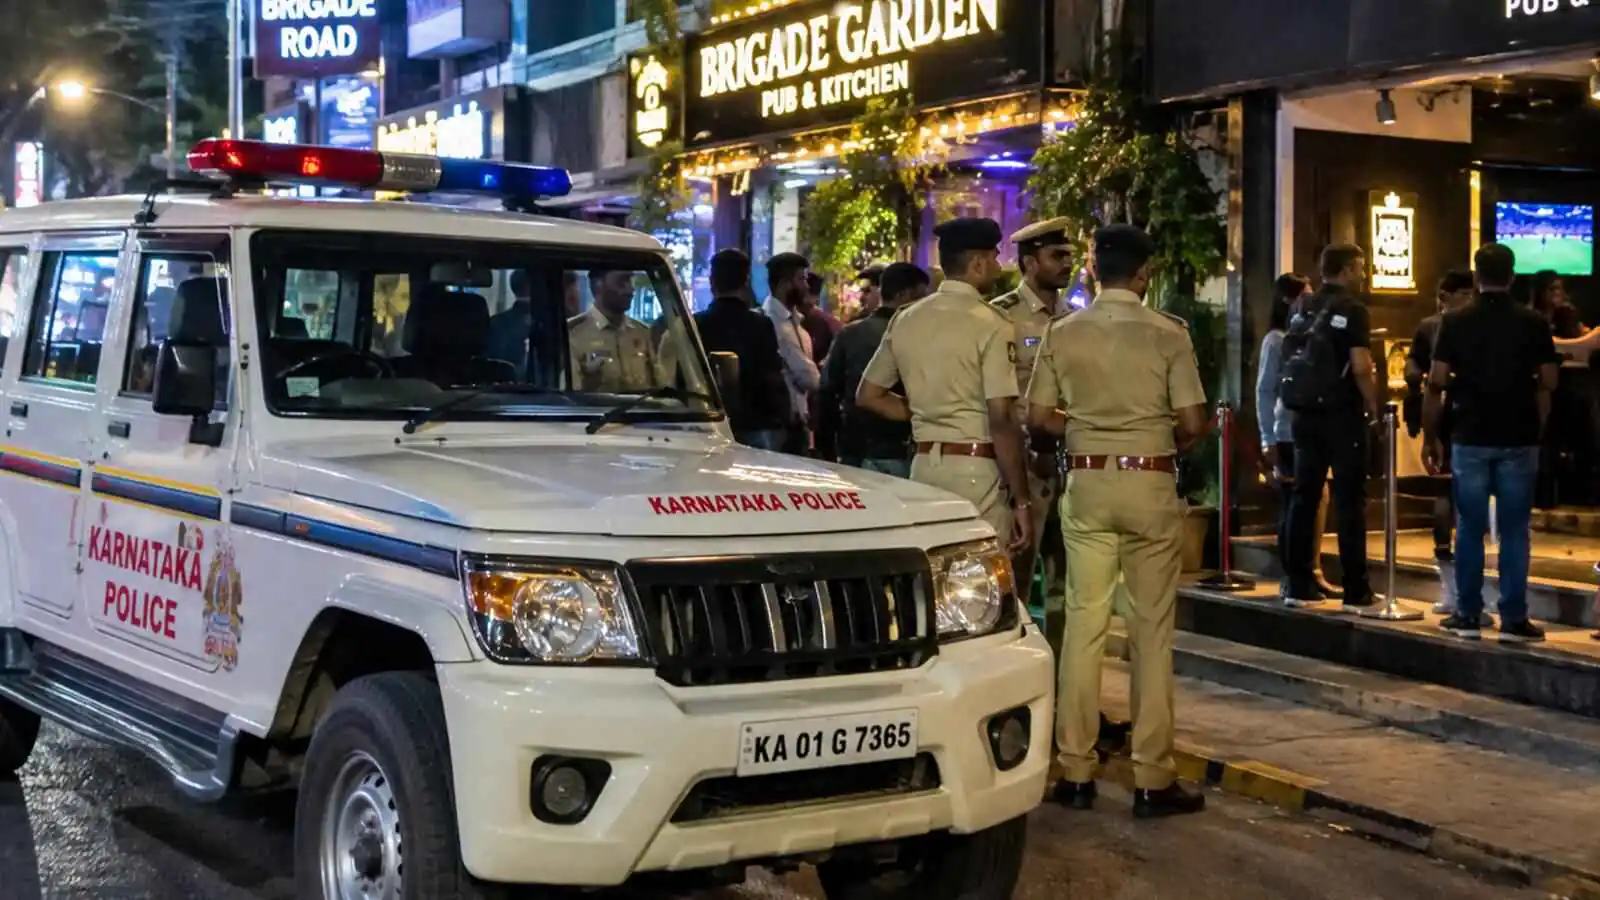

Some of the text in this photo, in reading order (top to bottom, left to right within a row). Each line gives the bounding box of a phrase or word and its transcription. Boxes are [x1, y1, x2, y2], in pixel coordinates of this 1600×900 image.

[261, 0, 377, 20] BRIGADE
[1505, 0, 1559, 18] PUB
[280, 24, 358, 58] ROAD
[700, 0, 998, 98] BRIGADE GARDEN
[761, 59, 910, 118] PUB & KITCHEN
[648, 491, 867, 515] KARNATAKA POLICE
[88, 525, 204, 593] KARNATAKA
[103, 580, 178, 640] POLICE
[754, 734, 788, 763] KA
[796, 730, 823, 759] 01
[831, 728, 848, 755] G
[855, 722, 912, 753] 7365
